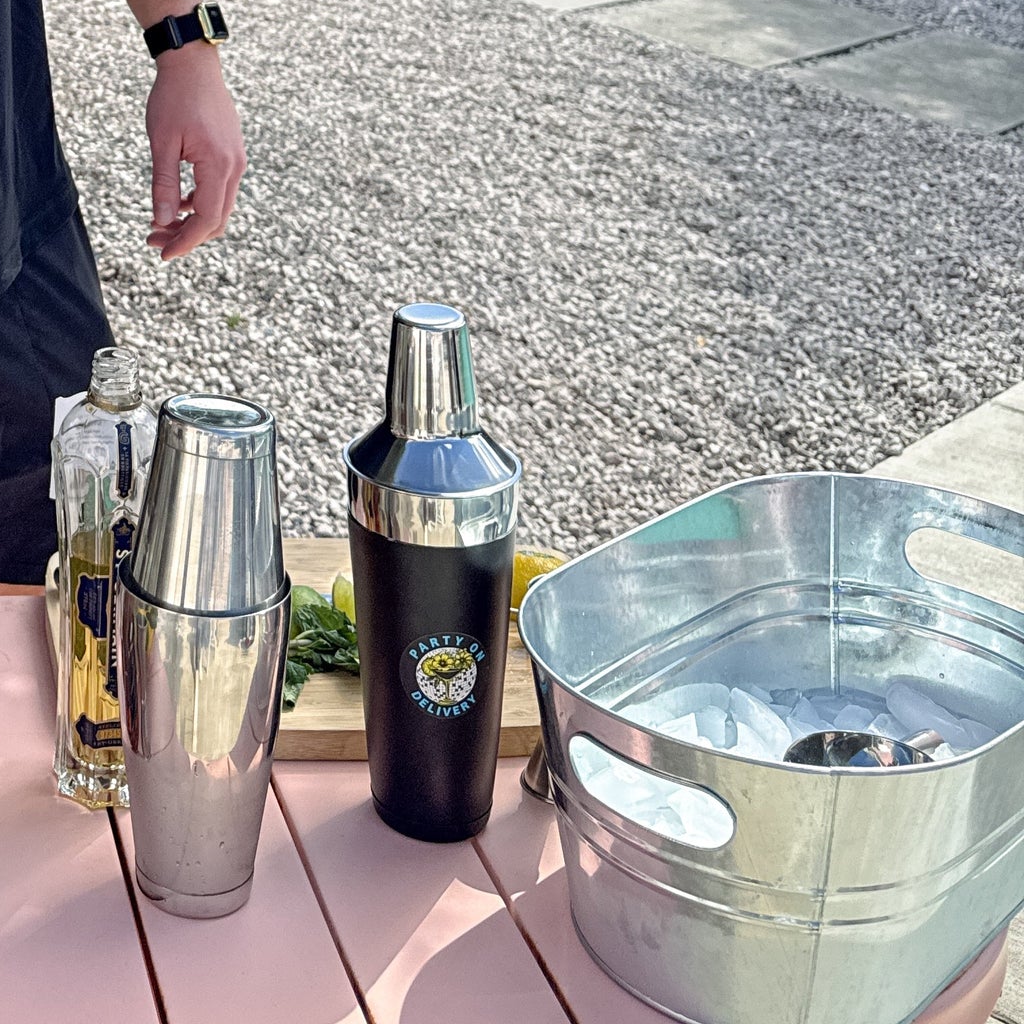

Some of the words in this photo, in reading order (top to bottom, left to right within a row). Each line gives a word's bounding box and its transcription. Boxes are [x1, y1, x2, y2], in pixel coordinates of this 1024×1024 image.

[409, 635, 464, 660] PARTY
[469, 643, 486, 662] ON
[410, 690, 477, 717] DELIVERY
